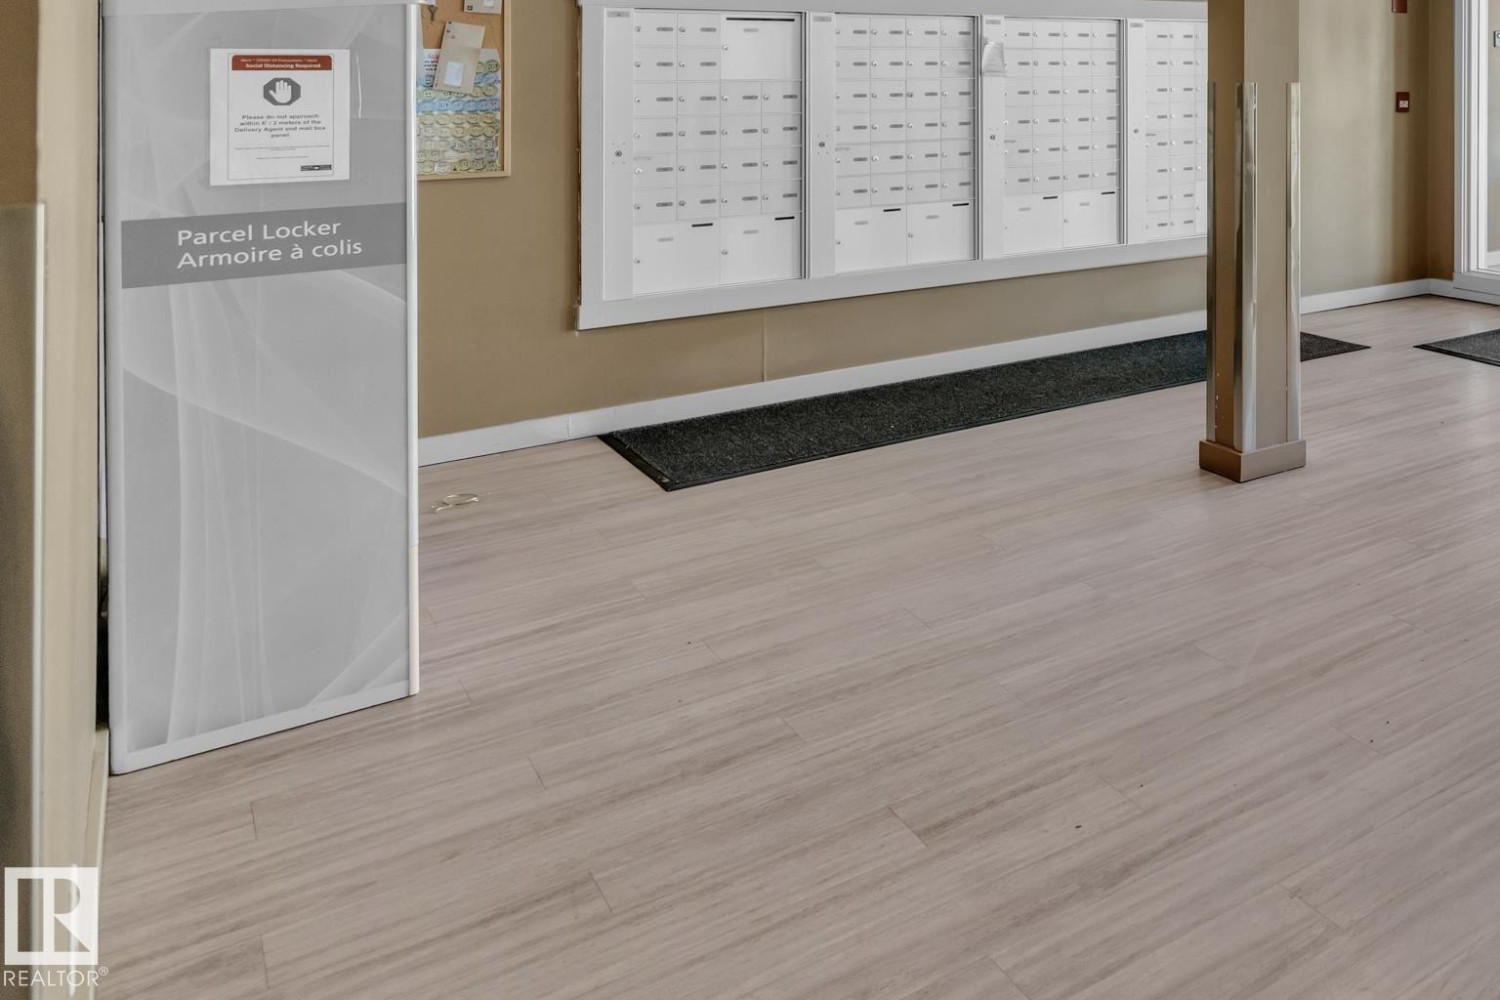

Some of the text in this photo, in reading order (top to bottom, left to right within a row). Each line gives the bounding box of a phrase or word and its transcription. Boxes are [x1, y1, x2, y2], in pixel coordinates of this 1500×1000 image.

[177, 220, 342, 246] Parcel Locker
[176, 239, 363, 269] Armoire à colis
